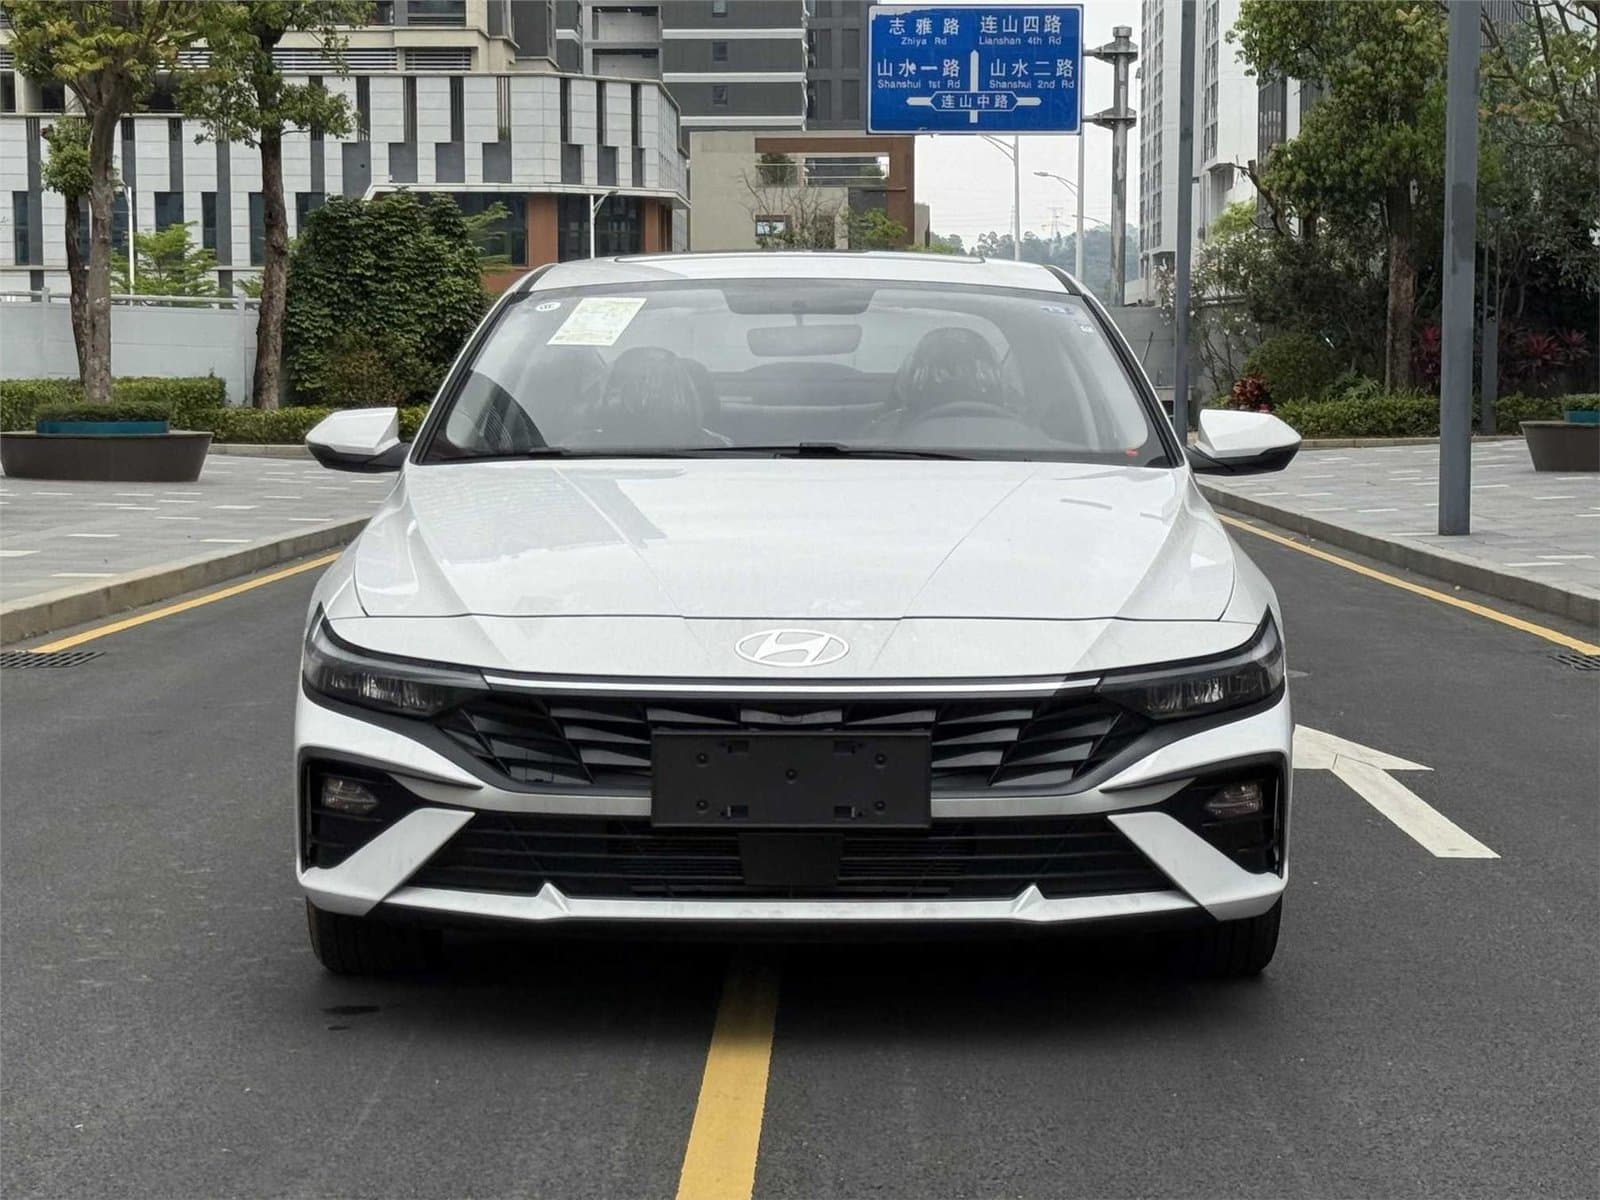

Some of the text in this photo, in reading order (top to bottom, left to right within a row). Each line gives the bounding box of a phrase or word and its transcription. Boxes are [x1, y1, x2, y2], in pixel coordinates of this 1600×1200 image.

[889, 17, 960, 36] 志雅路
[980, 15, 1062, 35] 连山四路
[901, 36, 948, 46] Zhiya Rd
[979, 36, 1062, 46] Lianshan 4th Rd
[877, 59, 960, 78] 山水一路
[990, 59, 1074, 78] 山水二路
[877, 79, 961, 89] Shanshui 1st Rd
[989, 79, 1075, 89] Shanshui 2nd Rd
[941, 94, 1008, 109] 连山中路
